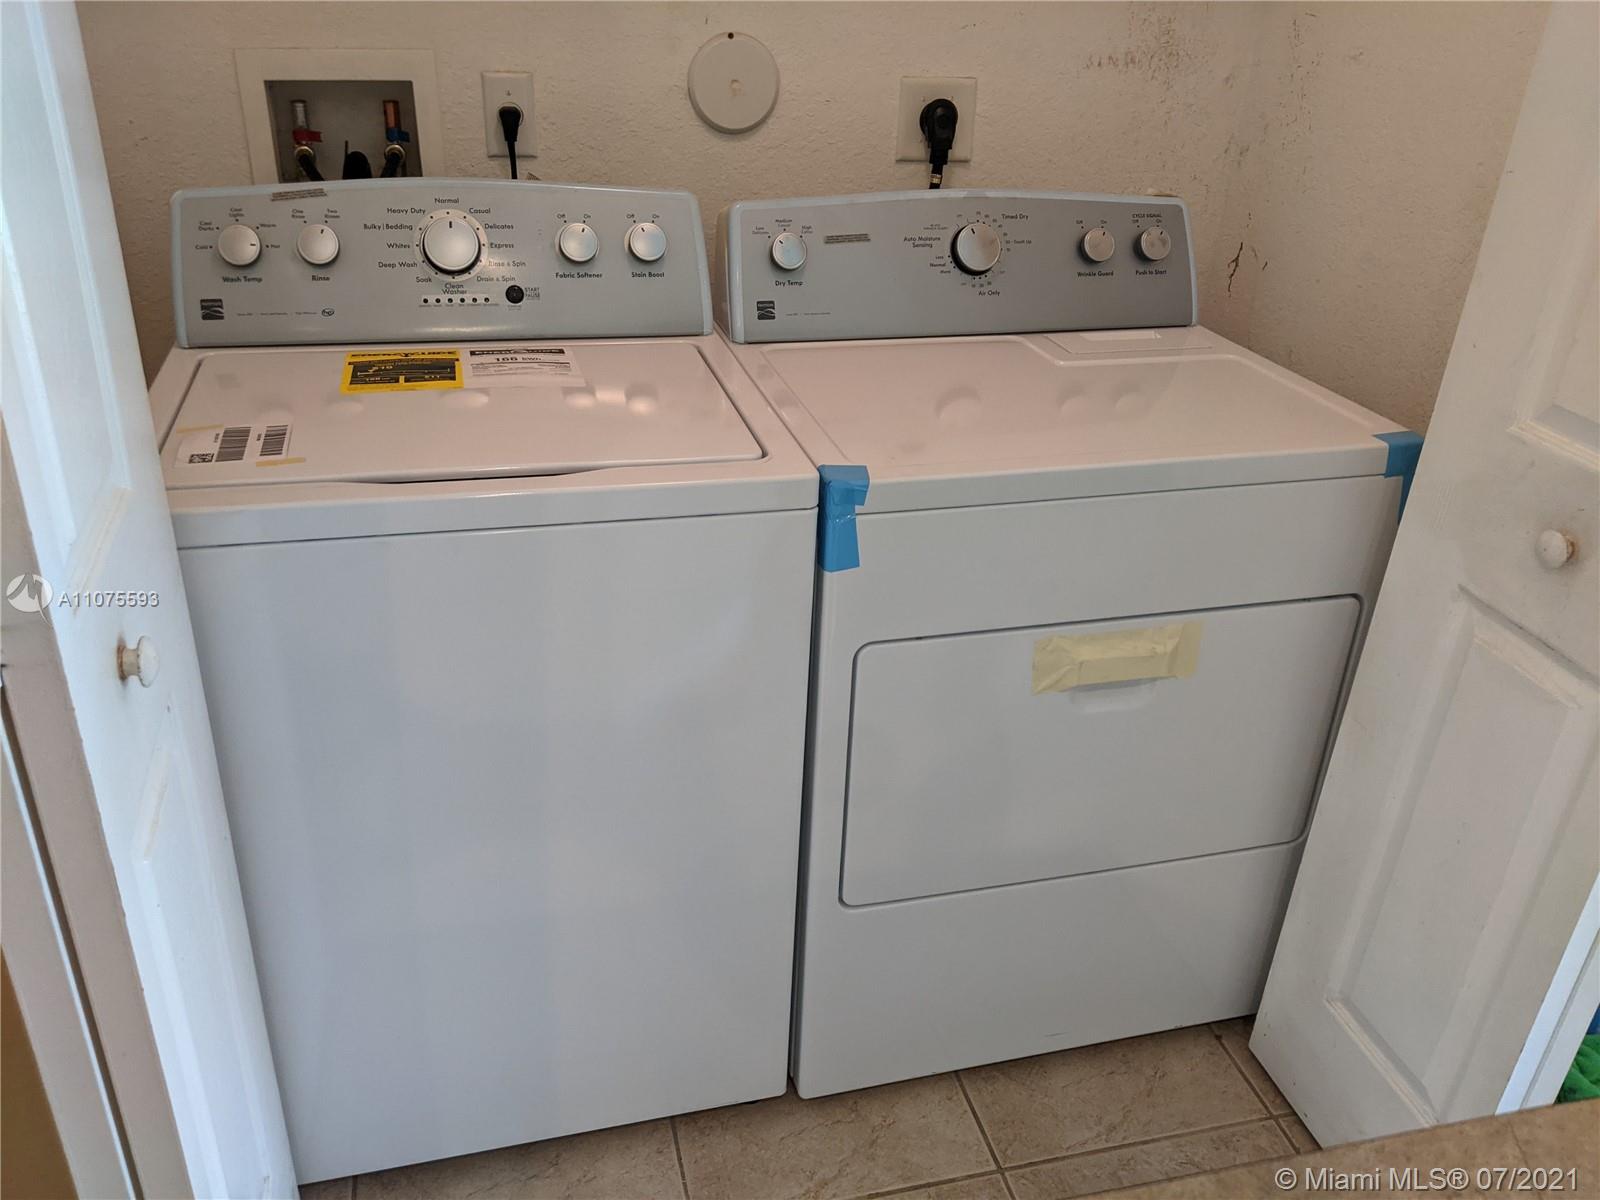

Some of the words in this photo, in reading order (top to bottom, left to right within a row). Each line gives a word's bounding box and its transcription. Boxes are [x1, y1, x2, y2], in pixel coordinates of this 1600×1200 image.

[386, 207, 408, 216] Heavy
[410, 207, 426, 216] Duty
[468, 207, 491, 215] Casual
[1019, 213, 1029, 221] Dry
[490, 242, 515, 250] Express
[378, 261, 397, 269] Deep
[511, 260, 527, 268] Spin
[555, 271, 575, 279] Fabric
[576, 271, 603, 279] Softener
[1076, 270, 1097, 278] Wrinkle
[222, 275, 242, 283] Wash
[242, 275, 263, 284] Temp
[501, 275, 516, 283] Spin
[775, 280, 786, 288] Dry
[987, 289, 1001, 298] Only
